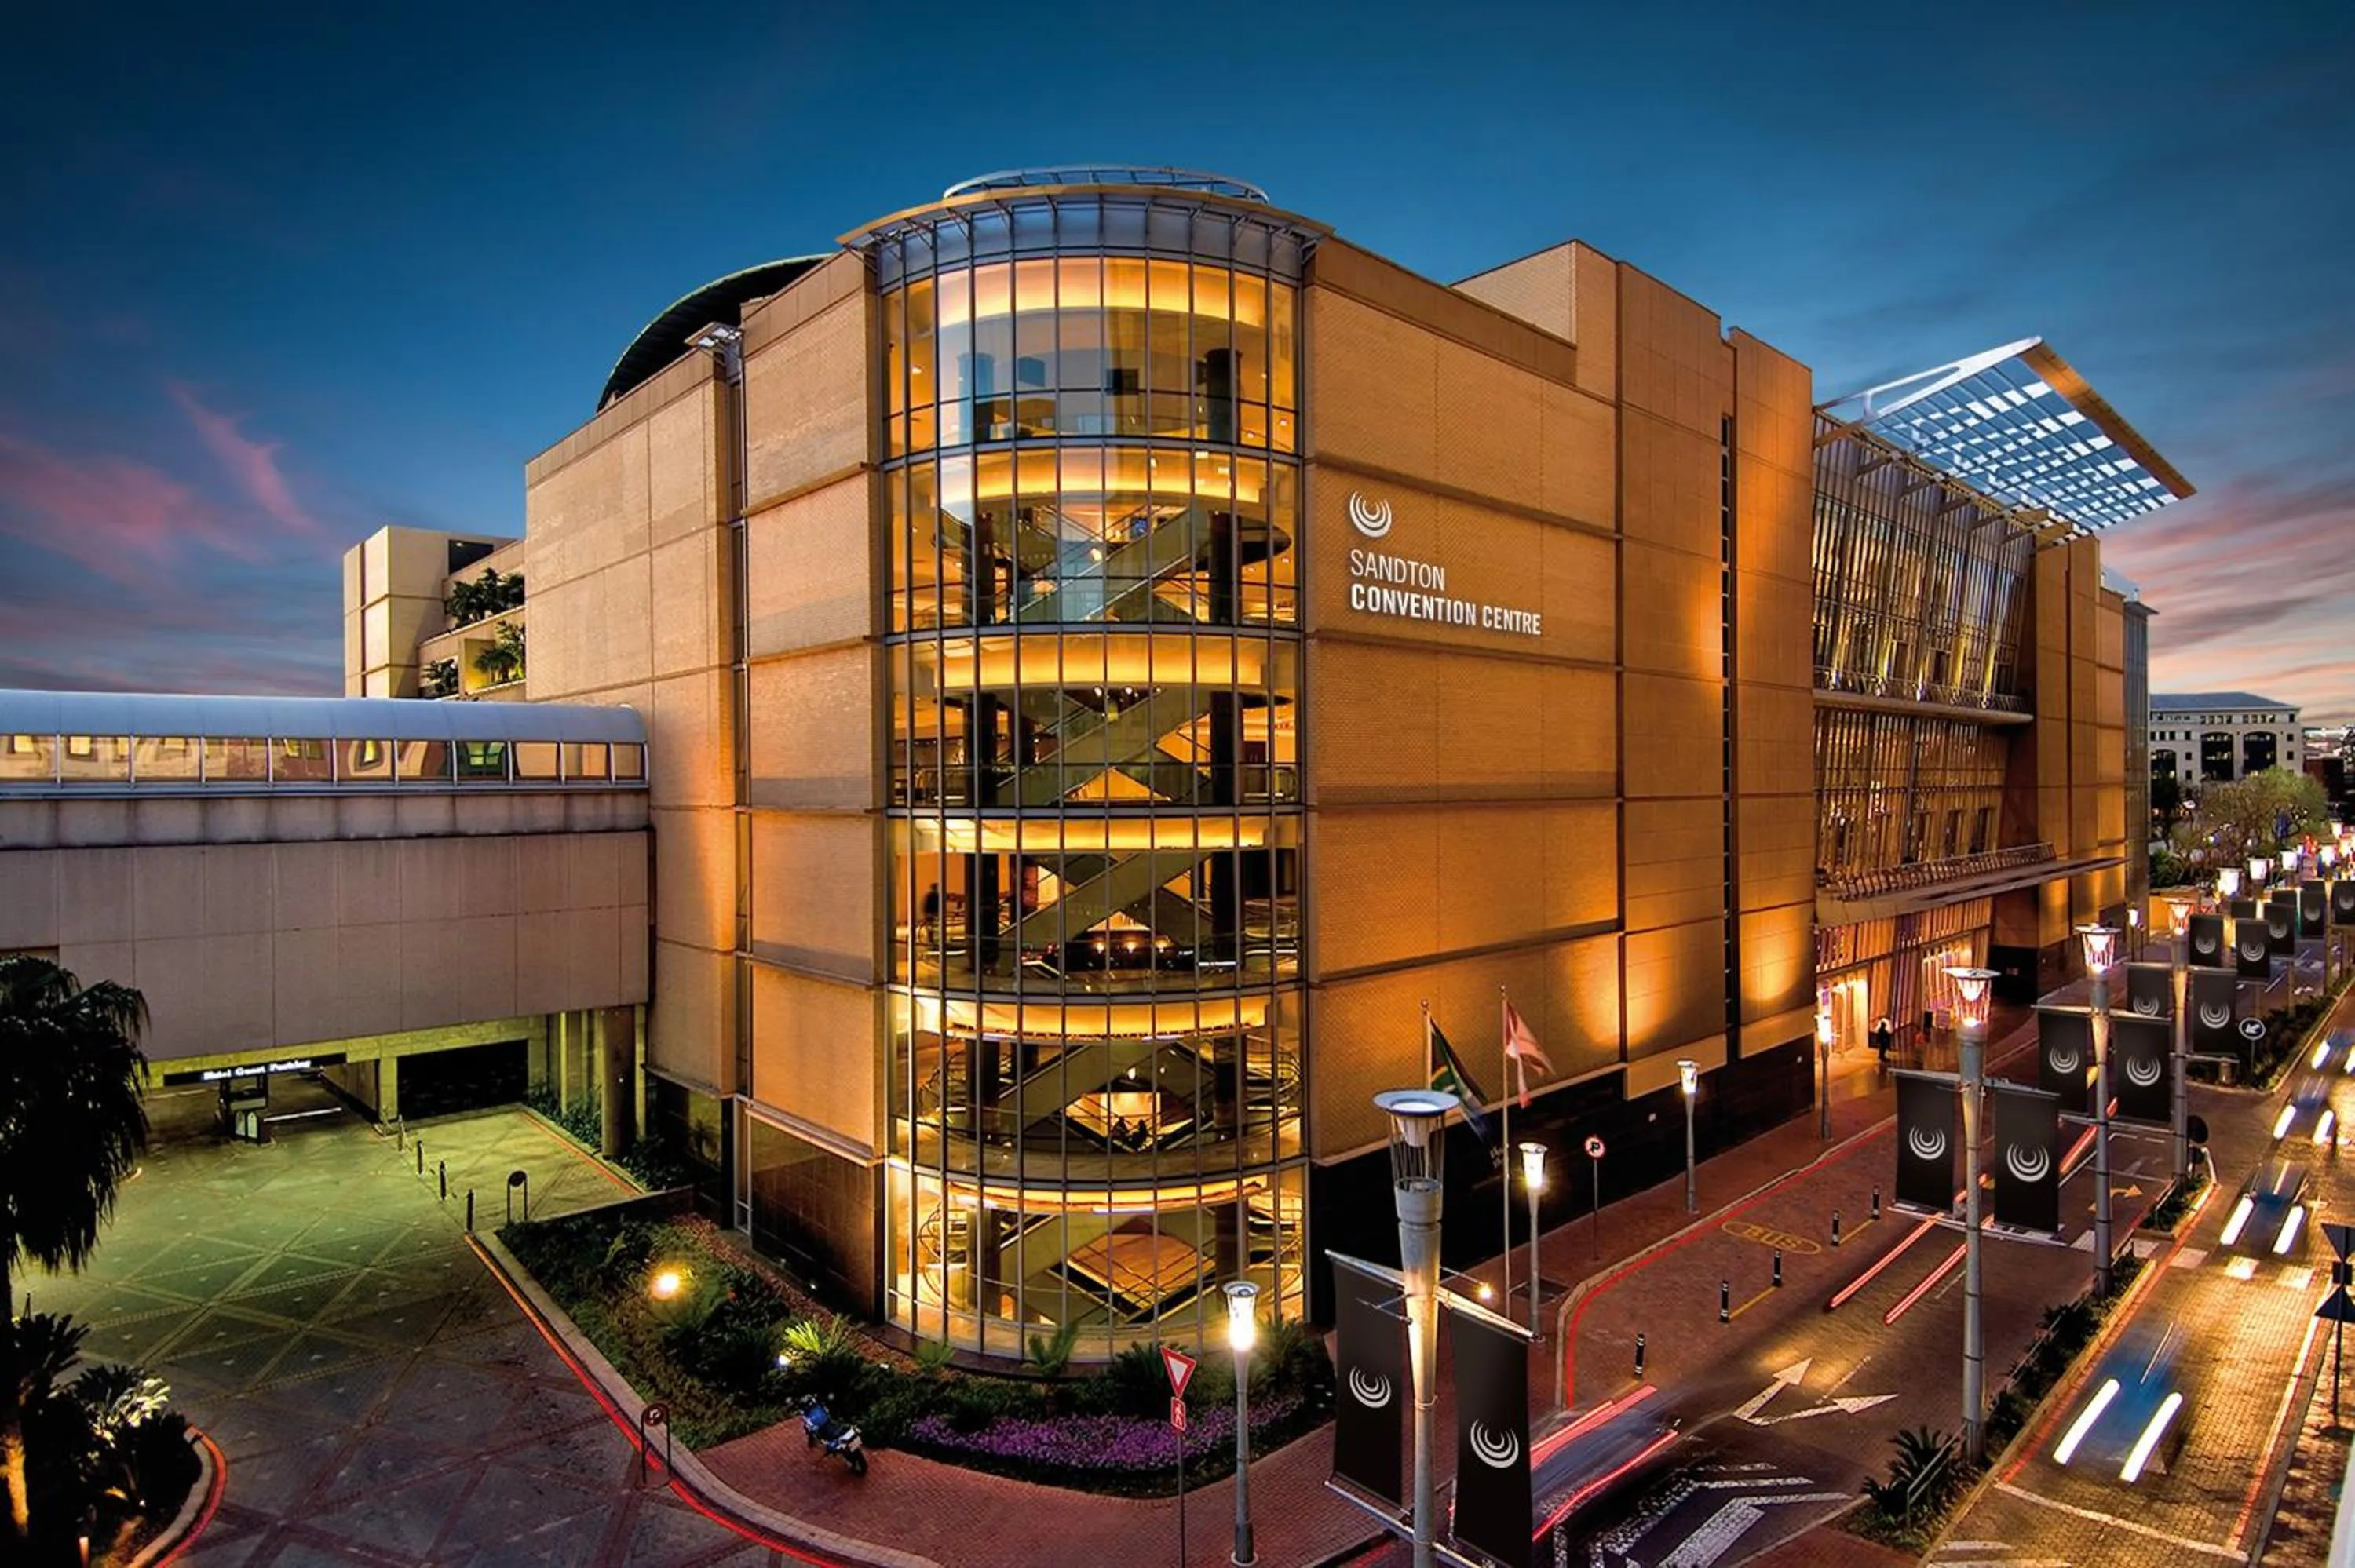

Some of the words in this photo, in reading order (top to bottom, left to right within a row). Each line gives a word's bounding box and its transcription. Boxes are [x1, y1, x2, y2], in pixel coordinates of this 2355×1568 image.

[1350, 549, 1445, 591] SANDTON
[1350, 583, 1477, 626] CONVENTION
[1482, 605, 1541, 635] CENTRE
[1743, 1225, 1802, 1249] BUS
